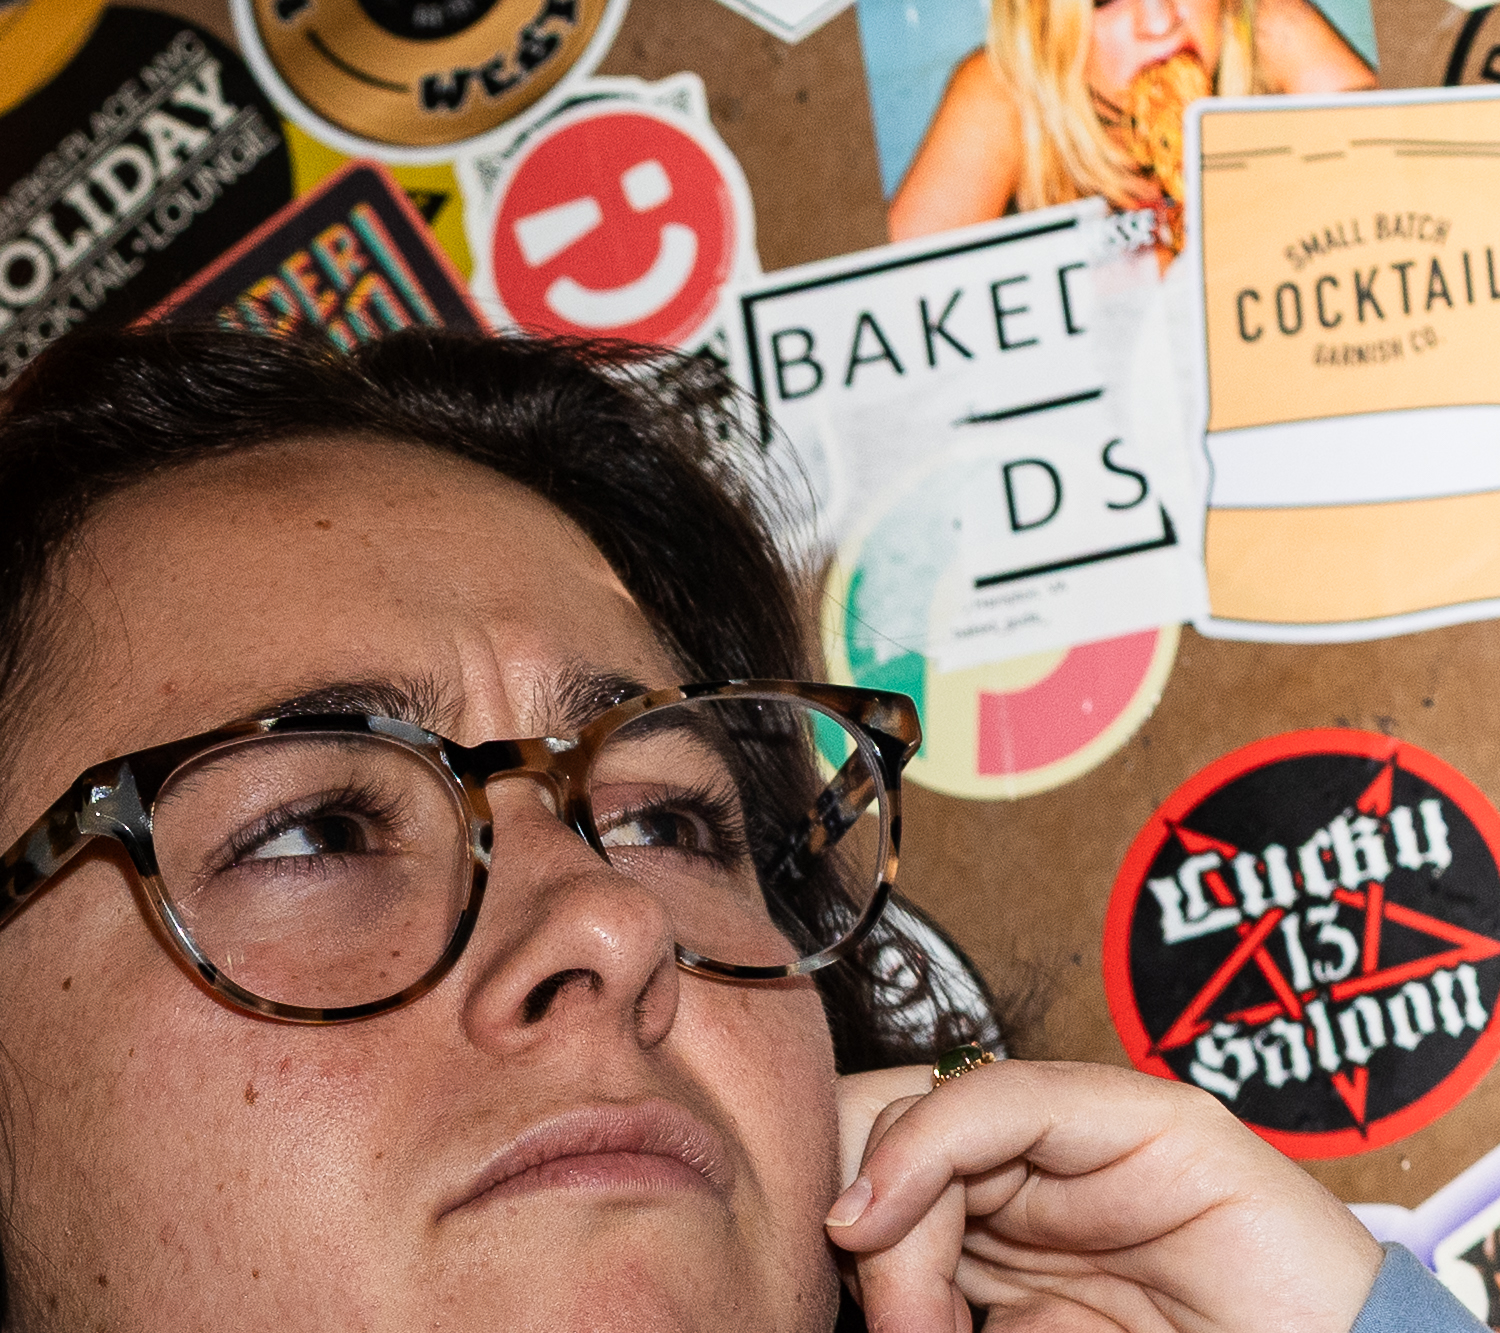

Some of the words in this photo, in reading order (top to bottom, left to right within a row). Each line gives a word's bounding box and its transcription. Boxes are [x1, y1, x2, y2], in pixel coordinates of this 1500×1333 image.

[1283, 218, 1365, 271] SMALL
[1374, 212, 1453, 245] BATCH
[1147, 798, 1455, 947] Lucky
[1280, 906, 1361, 1002] 13
[1188, 961, 1491, 1103] Saloon
